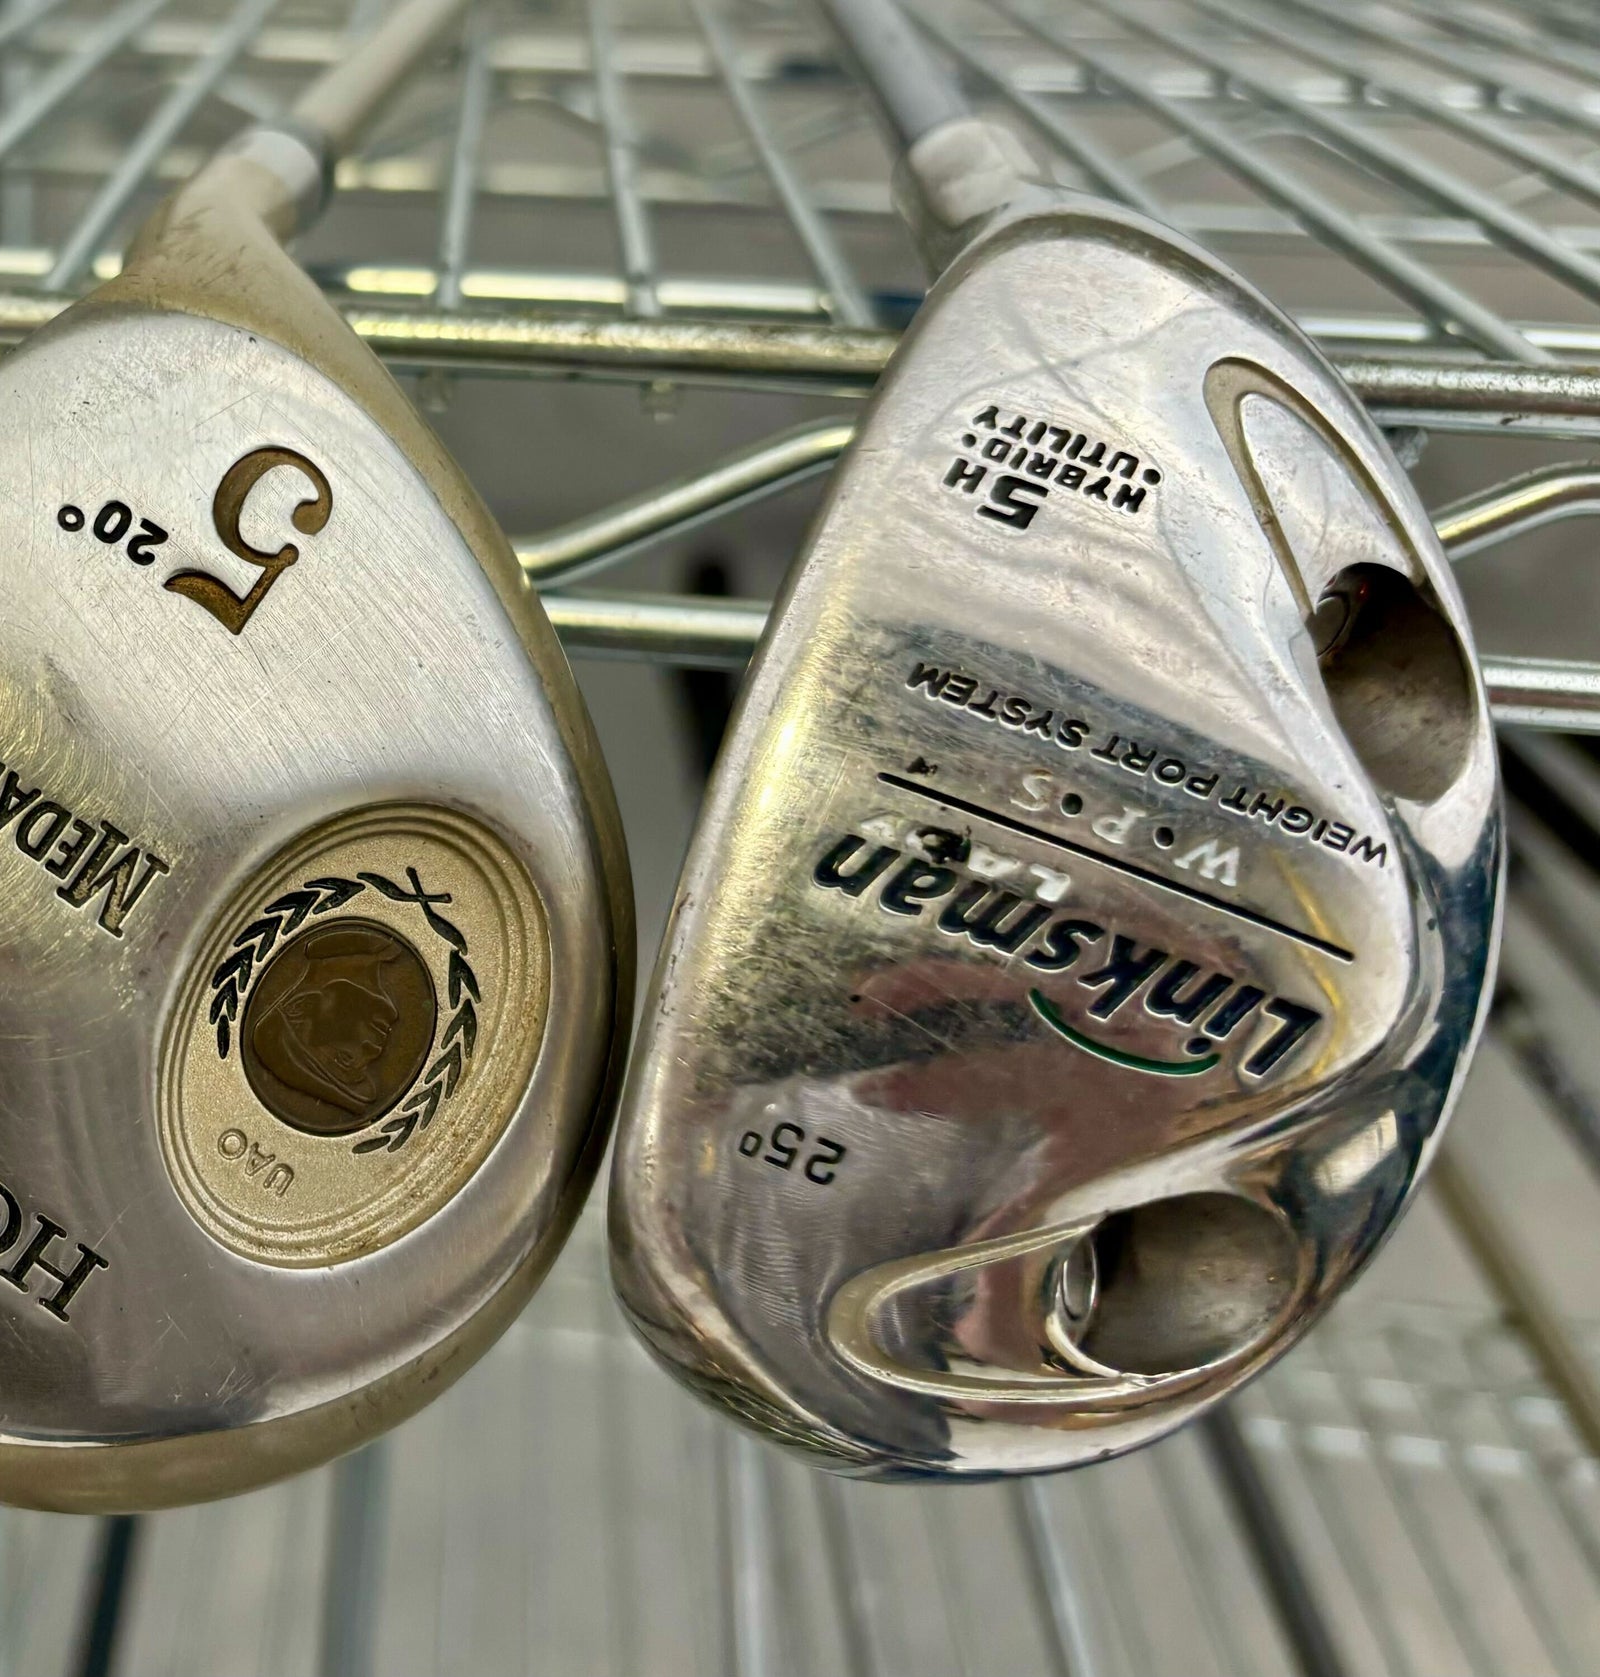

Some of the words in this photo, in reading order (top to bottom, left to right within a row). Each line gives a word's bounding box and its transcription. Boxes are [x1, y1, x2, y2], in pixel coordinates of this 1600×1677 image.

[56, 499, 169, 567] 20°
[164, 446, 333, 637] 5
[905, 662, 1090, 750] SYSTEM
[1090, 735, 1219, 801] PORT
[1218, 785, 1388, 869] WEIGHT
[812, 834, 1320, 1078] Linksman
[738, 1122, 847, 1186] 25°
